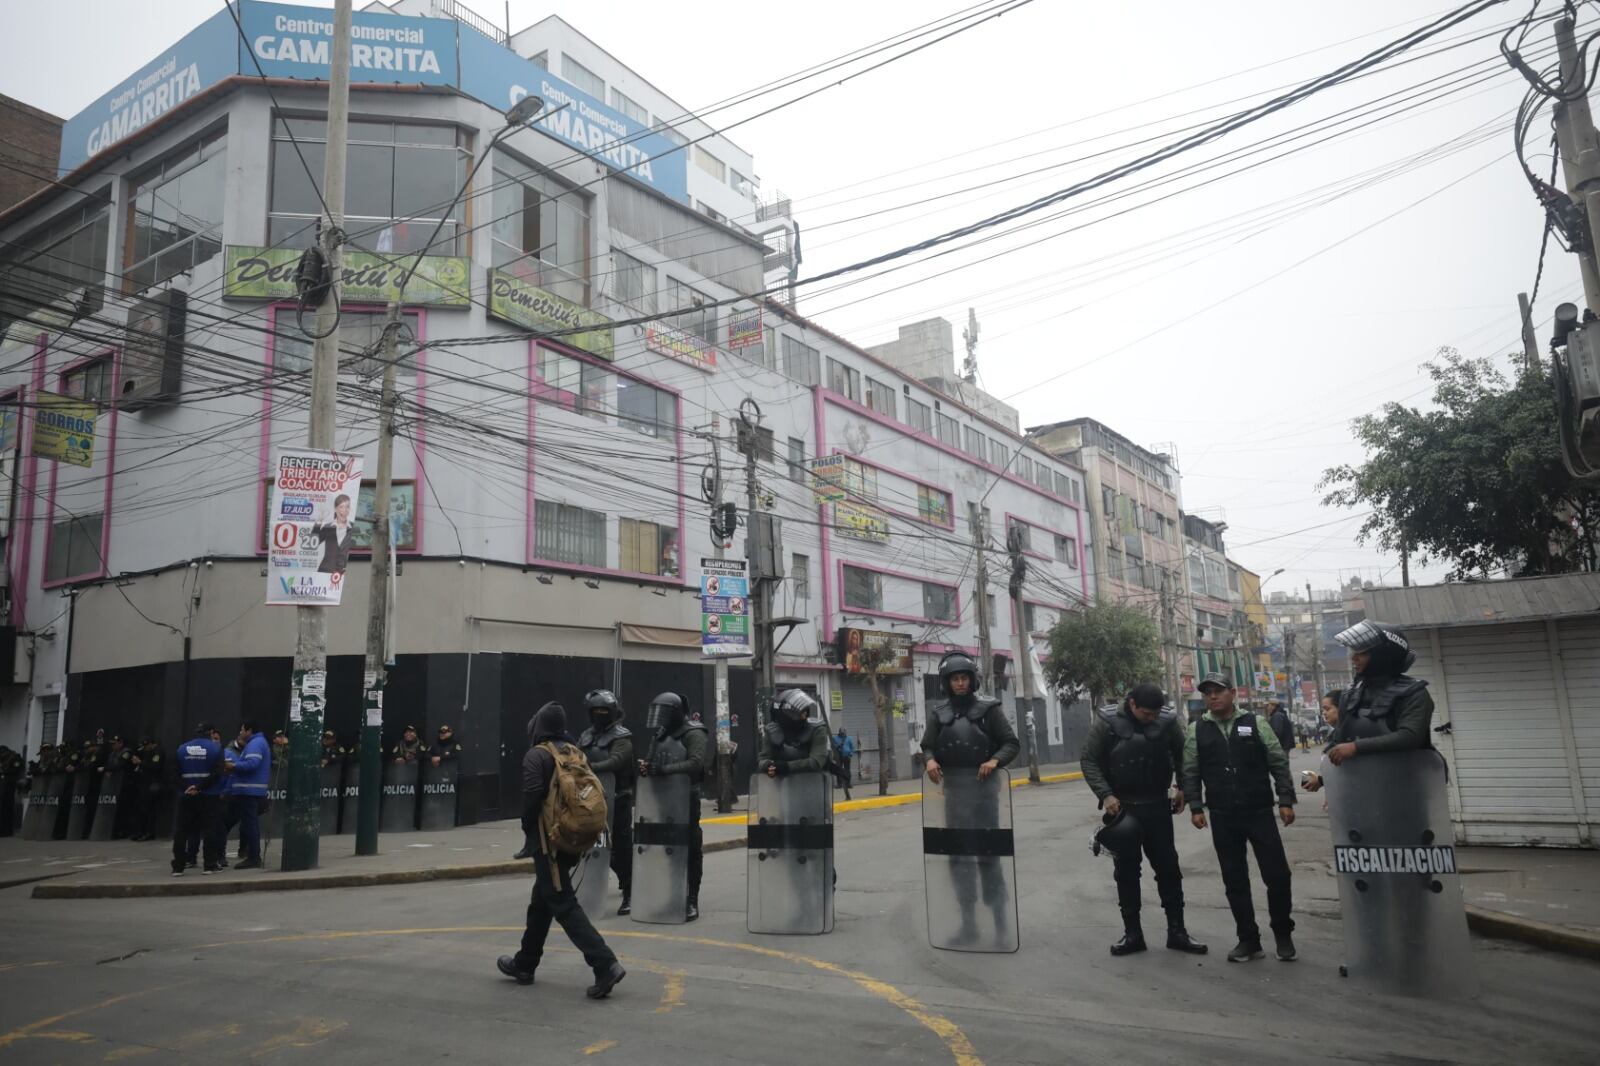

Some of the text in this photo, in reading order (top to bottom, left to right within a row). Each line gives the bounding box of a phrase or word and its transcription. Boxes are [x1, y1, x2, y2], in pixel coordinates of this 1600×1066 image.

[275, 15, 424, 44] Centro omercial
[110, 55, 177, 113] Centro Comercial
[86, 62, 201, 158] GAMARRITA
[541, 80, 627, 137] Centro Comercial
[37, 410, 94, 435] GORROS
[282, 457, 342, 471] BENEFICIO
[812, 456, 843, 468] POLOS
[282, 468, 347, 482] TRIBUTARIO
[279, 478, 339, 491] COACTIVO
[291, 506, 312, 514] JULIO
[277, 523, 294, 549] 0
[302, 535, 319, 549] 20
[301, 576, 313, 586] LA
[266, 789, 287, 800] OLIC
[384, 785, 415, 795] POLICIA
[424, 783, 455, 794] POLICIA
